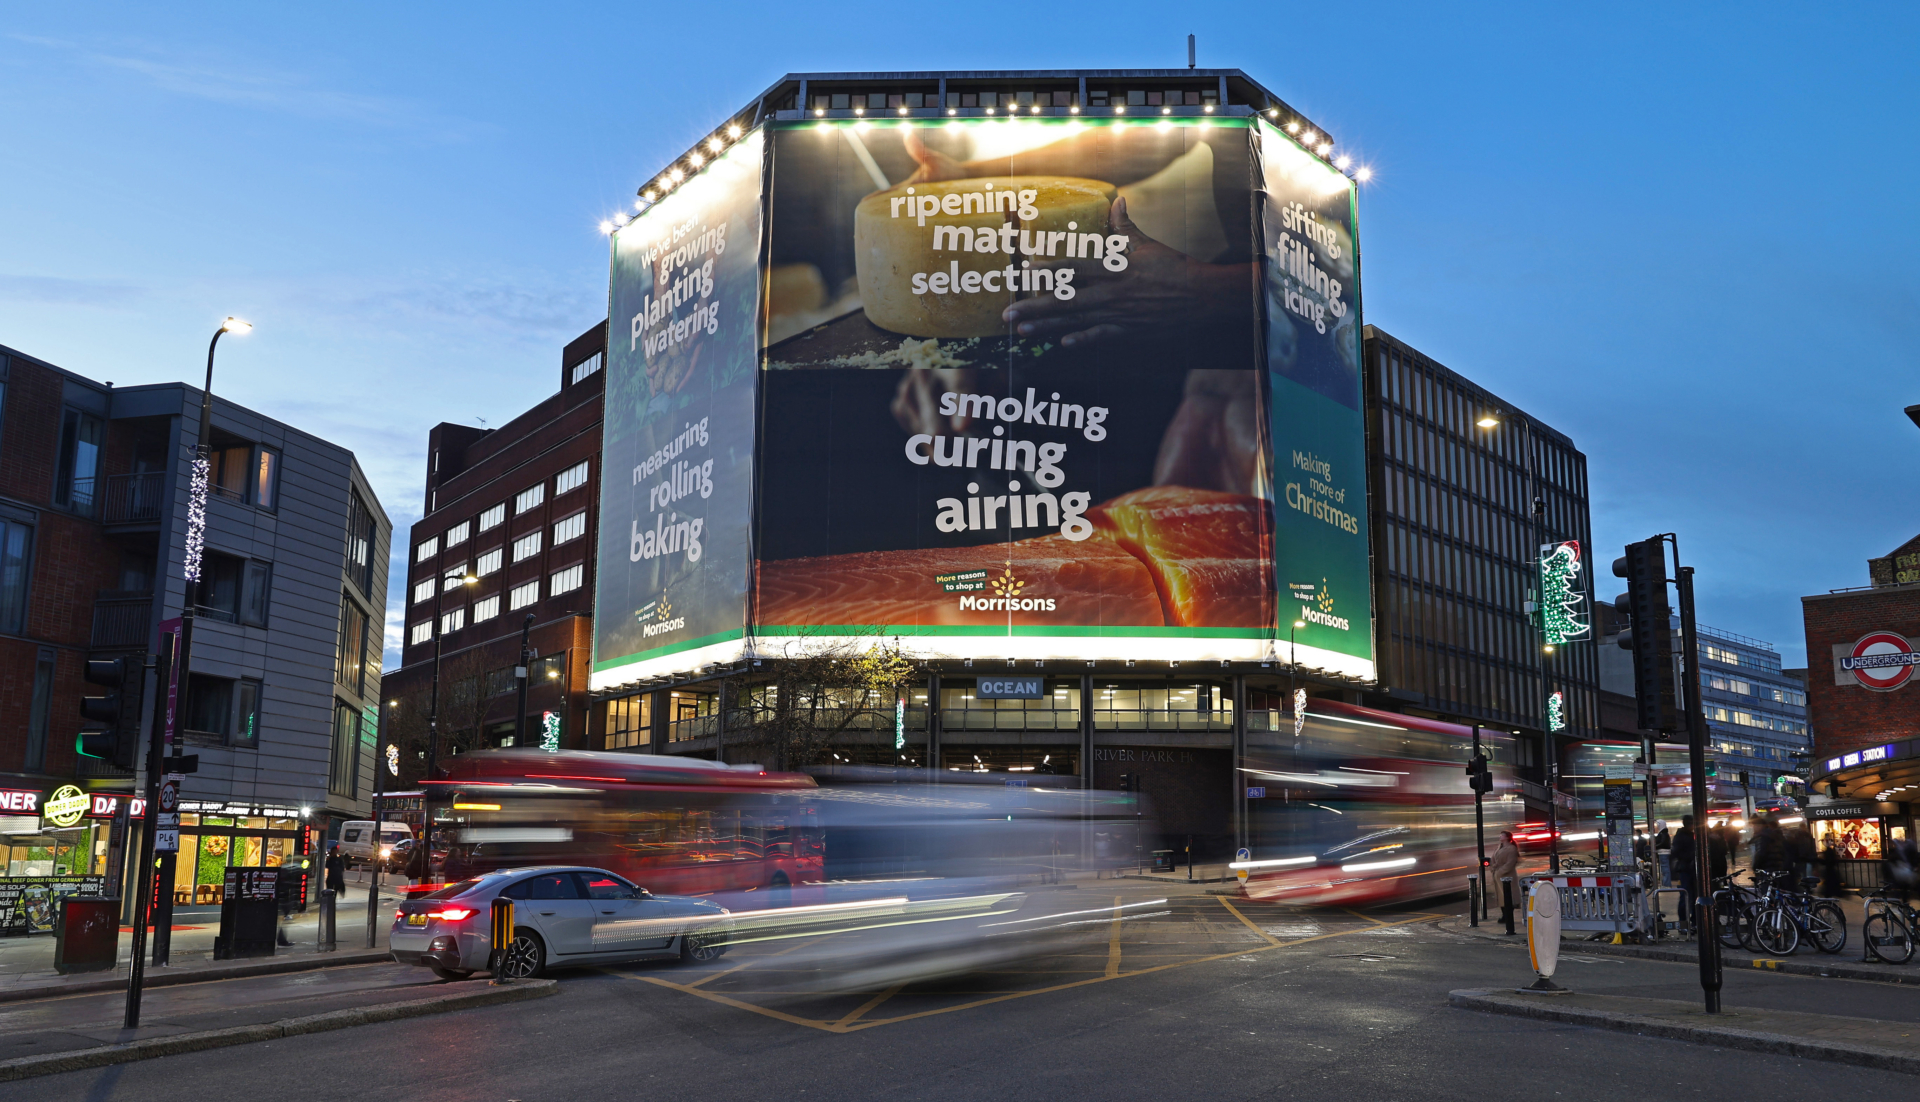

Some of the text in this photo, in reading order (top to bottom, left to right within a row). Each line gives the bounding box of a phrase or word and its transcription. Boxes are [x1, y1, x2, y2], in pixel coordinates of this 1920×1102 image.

[891, 182, 1039, 227] ripening
[641, 213, 699, 269] We've been
[932, 221, 1130, 273] maturing
[1282, 200, 1342, 260] sifting,
[659, 221, 727, 286] growing
[1277, 231, 1347, 318] filling,
[911, 260, 1076, 300] selecting
[631, 257, 714, 352] planting
[1284, 279, 1326, 335] icing
[644, 300, 720, 359] watering
[939, 387, 1109, 442] smoking
[632, 416, 709, 486] measuring
[905, 425, 1067, 489] curing
[1292, 449, 1332, 483] Making
[649, 458, 714, 513] rolling
[1309, 477, 1346, 504] more of
[935, 480, 1094, 542] airing
[1286, 482, 1359, 535] Christmas
[629, 512, 704, 563] baking
[936, 571, 986, 583] More reasons
[955, 583, 975, 591] shop
[959, 593, 1056, 611] Morrisons
[1301, 605, 1350, 631] Morrisons
[643, 615, 685, 638] Morrisons
[1842, 652, 1920, 670] UNDERGROUND
[981, 681, 1037, 694] OCEAN
[1094, 749, 1135, 762] RIVER
[1141, 751, 1175, 763] PARK
[1862, 746, 1886, 762] STATION
[47, 798, 88, 814] DONER DADDY
[163, 791, 174, 802] 20
[159, 833, 174, 842] PL6
